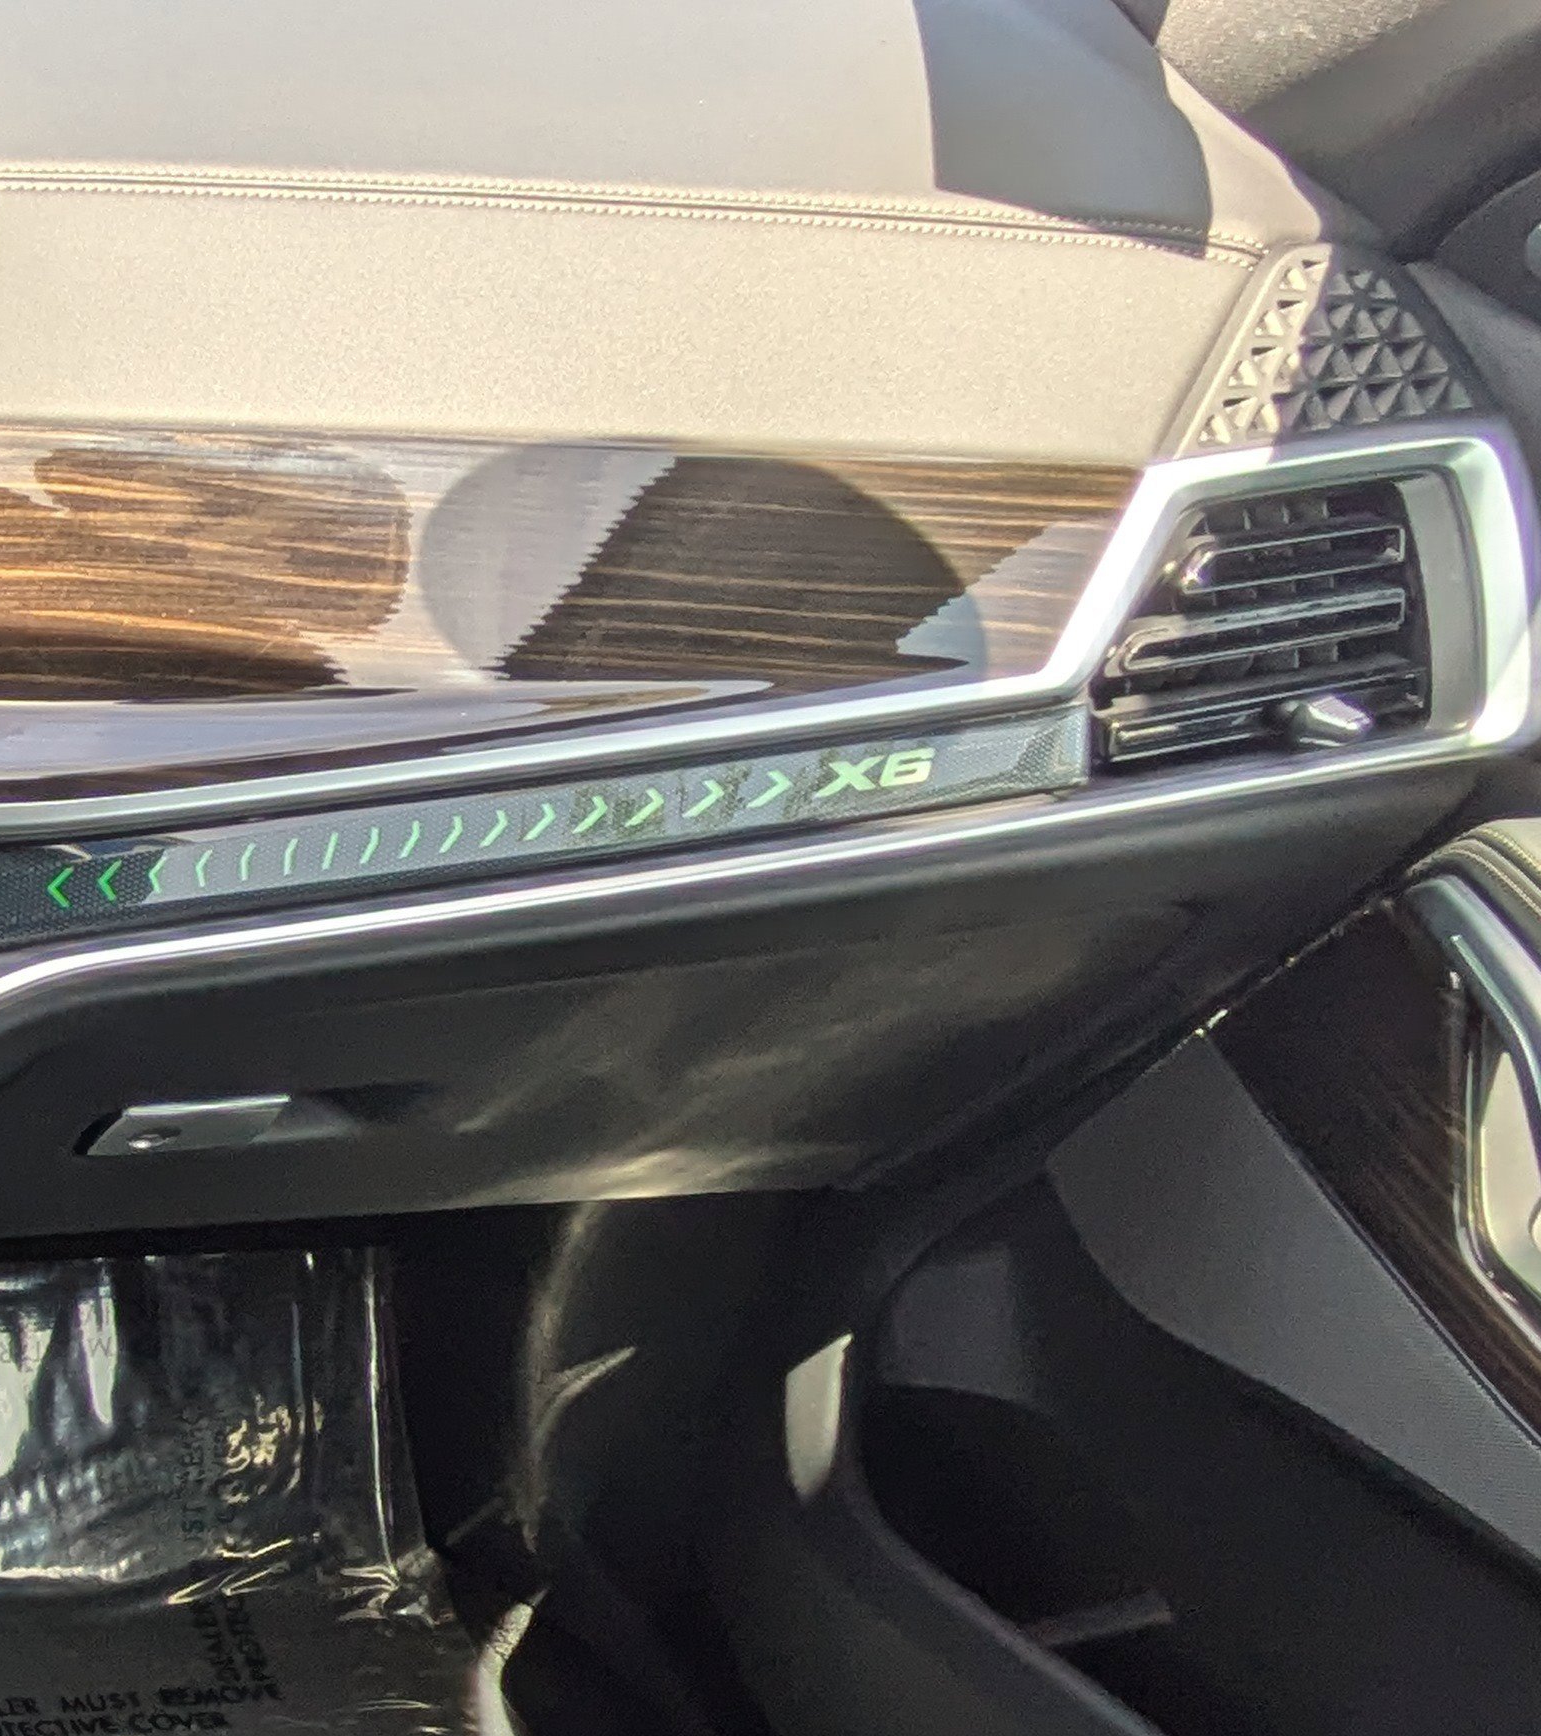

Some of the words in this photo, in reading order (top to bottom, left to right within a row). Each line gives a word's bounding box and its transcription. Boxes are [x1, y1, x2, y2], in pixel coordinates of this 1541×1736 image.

[811, 746, 937, 800] X6
[59, 1689, 142, 1715] MUST
[156, 1681, 283, 1707] REMOVE
[126, 1707, 230, 1736] COVER
